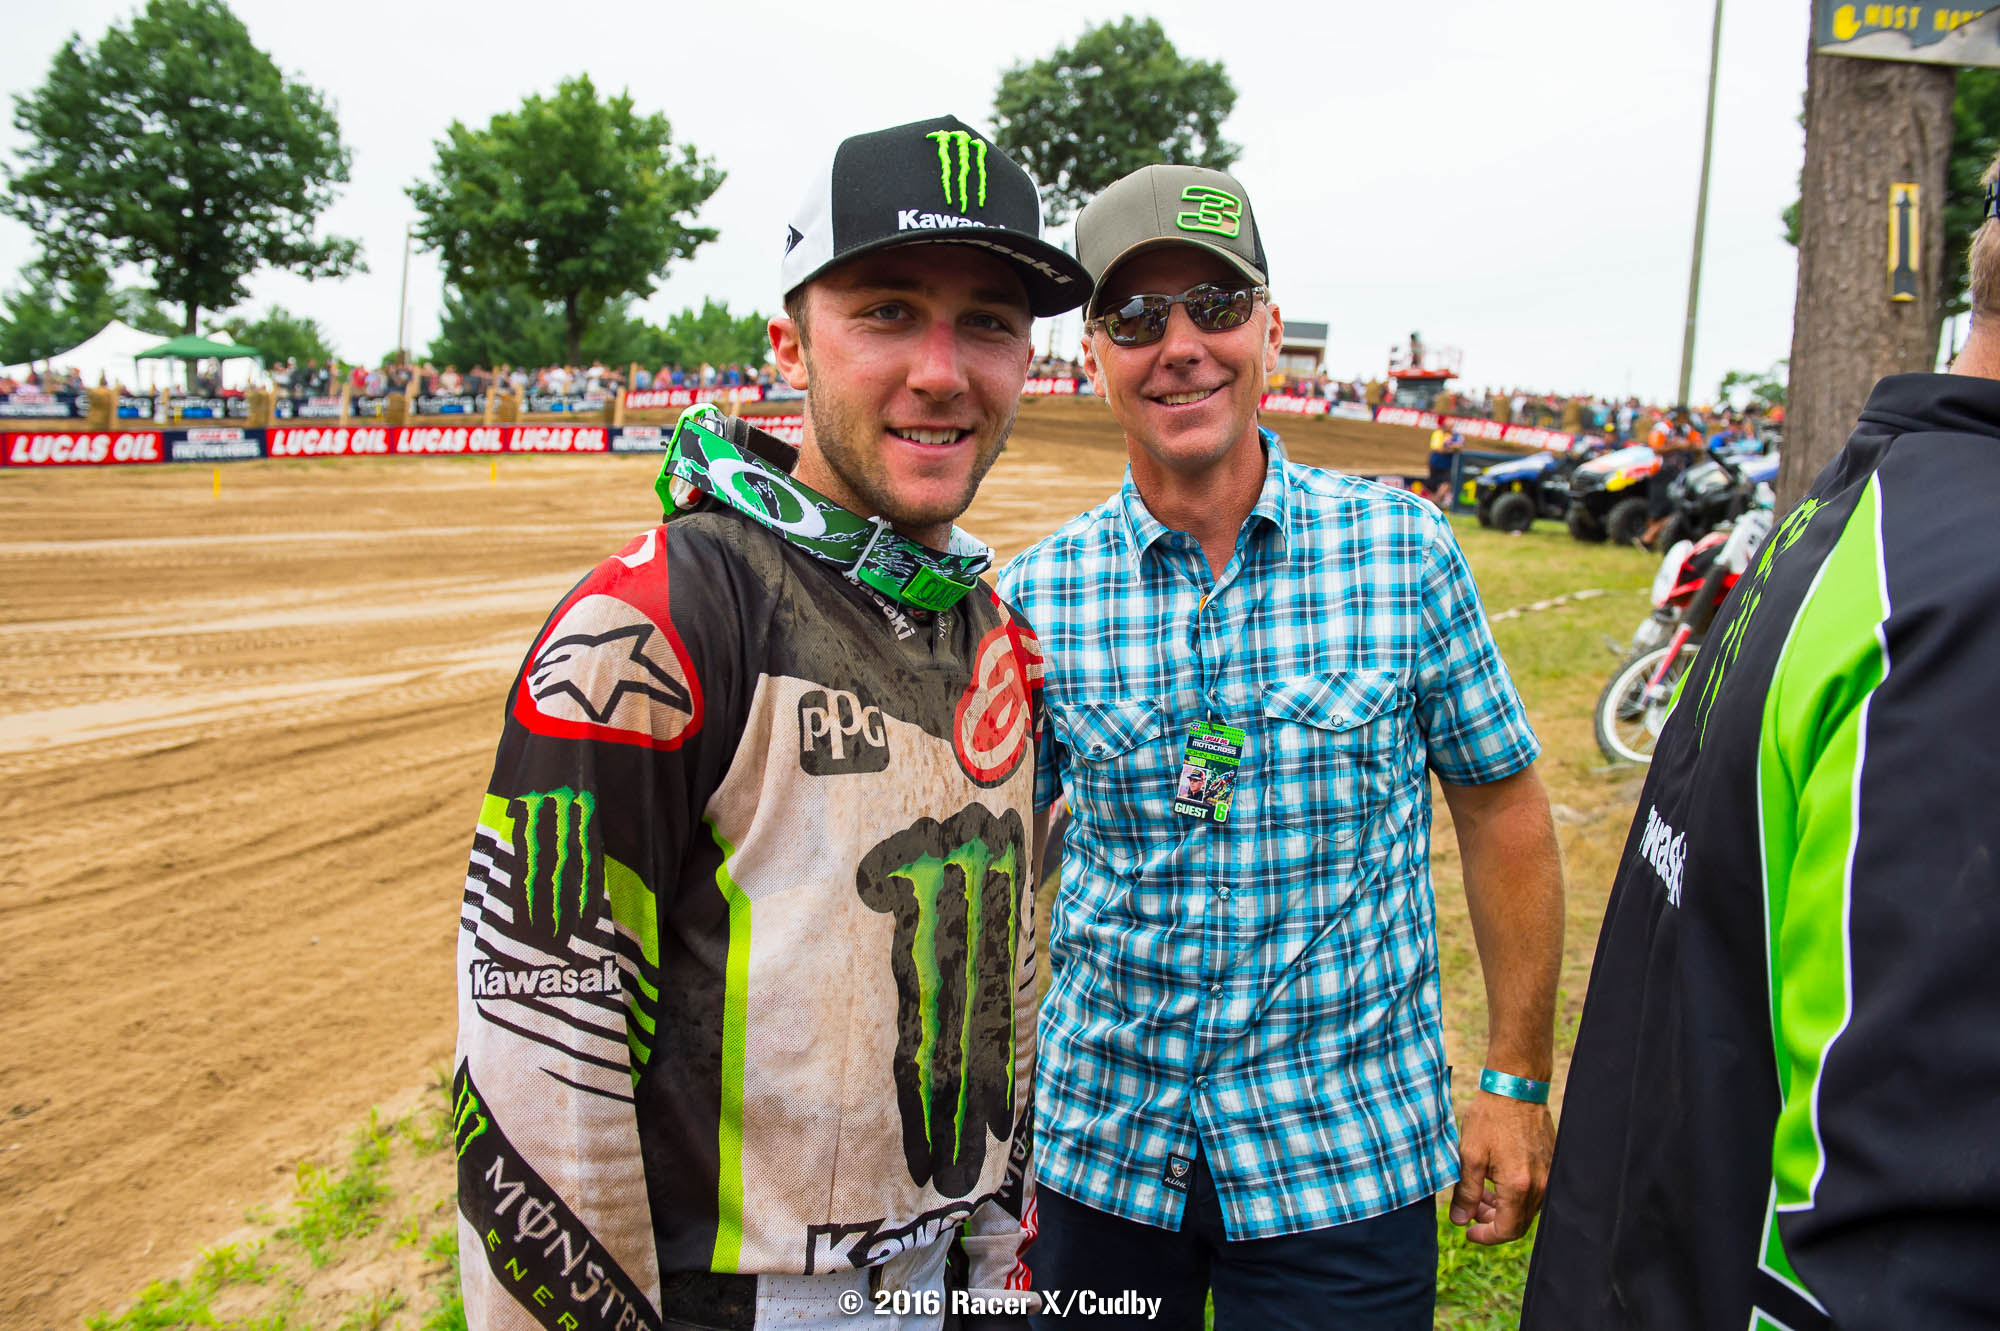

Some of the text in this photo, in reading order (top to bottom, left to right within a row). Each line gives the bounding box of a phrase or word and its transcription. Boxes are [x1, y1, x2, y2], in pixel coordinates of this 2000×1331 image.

[10, 433, 158, 463] LUCAS OIL
[271, 428, 388, 455] LUCAS OIL
[396, 427, 503, 453] LUCAS OIL
[509, 427, 574, 452] LUCAS
[574, 427, 605, 450] OIL
[1192, 740, 1237, 755] MOTOCROSS
[1174, 802, 1208, 819] GUEST
[1214, 801, 1229, 822] 6
[485, 1154, 651, 1331] MONSTE
